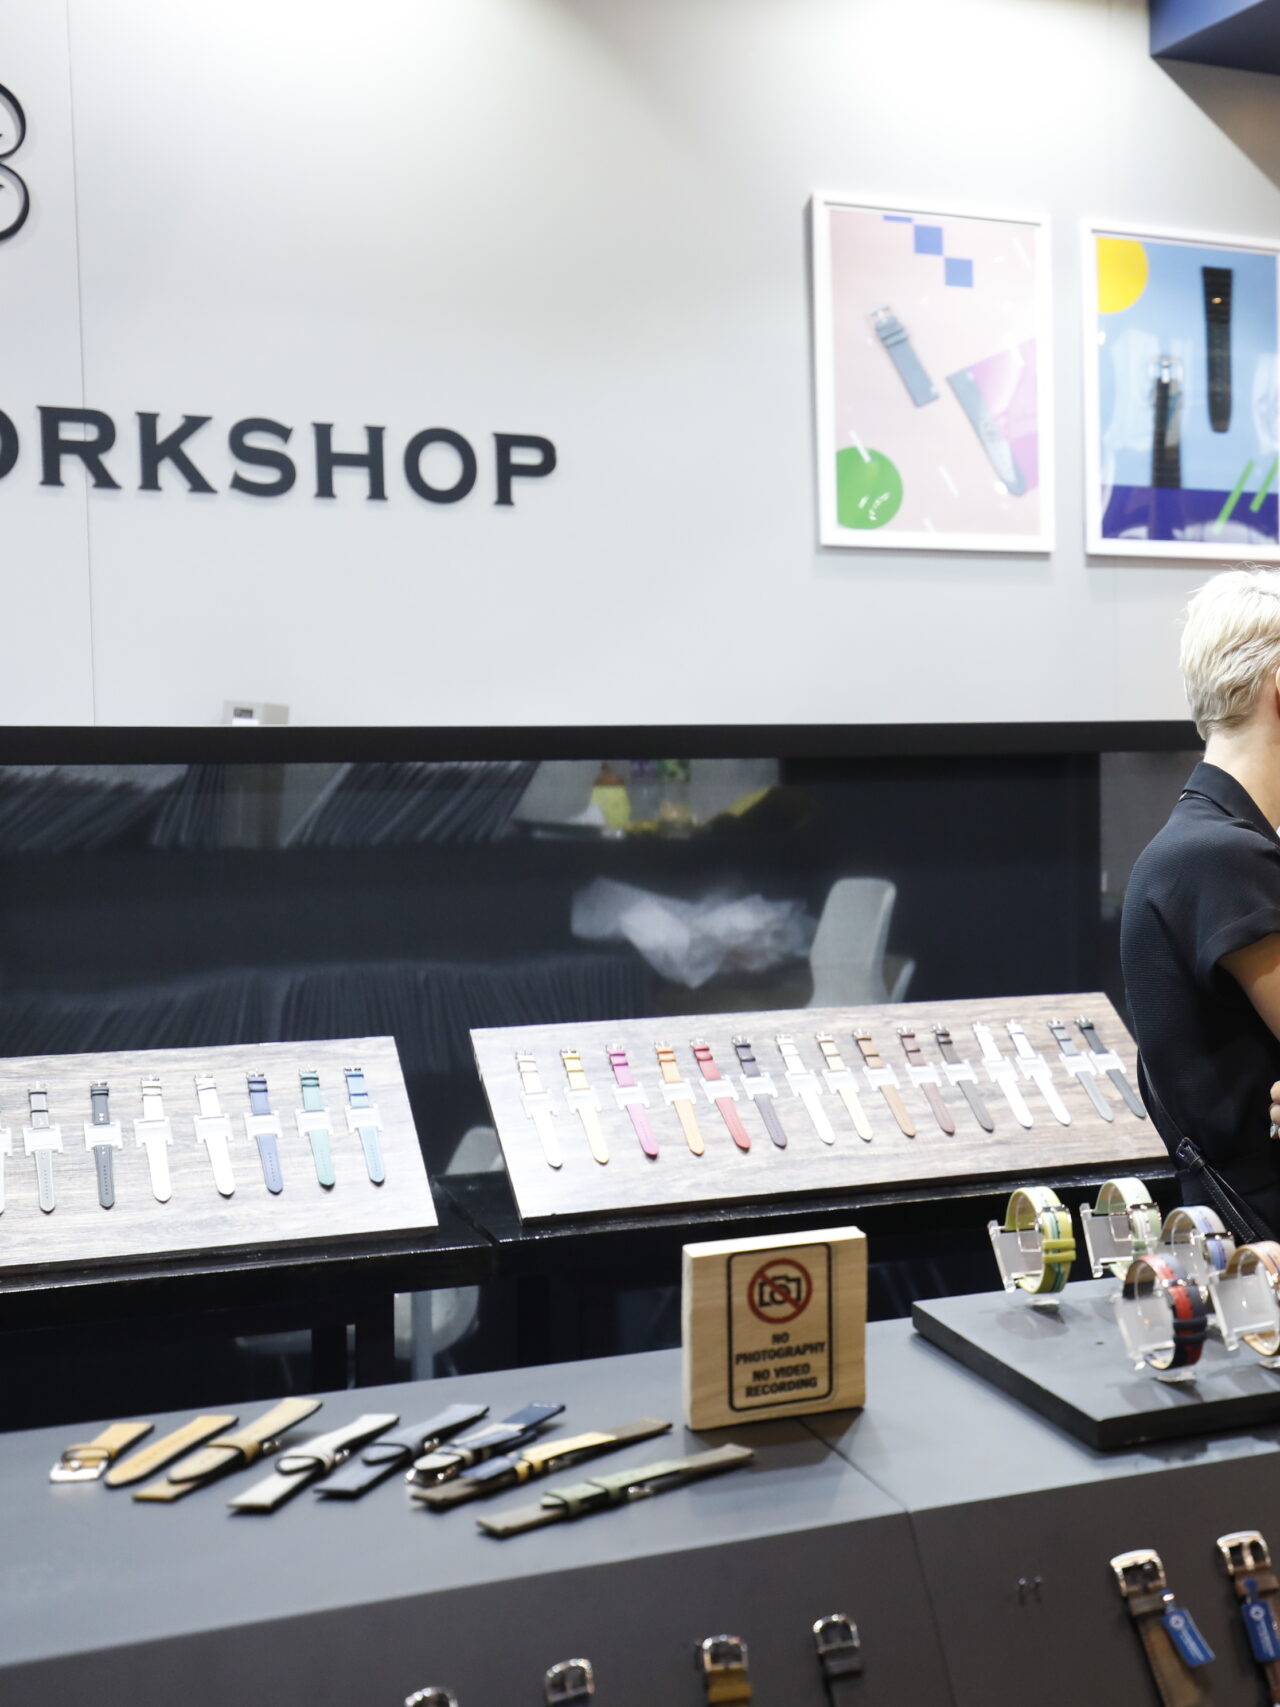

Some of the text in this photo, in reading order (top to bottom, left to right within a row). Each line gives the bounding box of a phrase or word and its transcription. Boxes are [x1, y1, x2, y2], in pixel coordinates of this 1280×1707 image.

[0, 405, 557, 506] RKSHOP
[771, 1332, 790, 1345] NO
[735, 1341, 825, 1365] PHOTOGRAPHY
[752, 1362, 811, 1381] NO VIDEO
[745, 1376, 818, 1398] RECORDING
